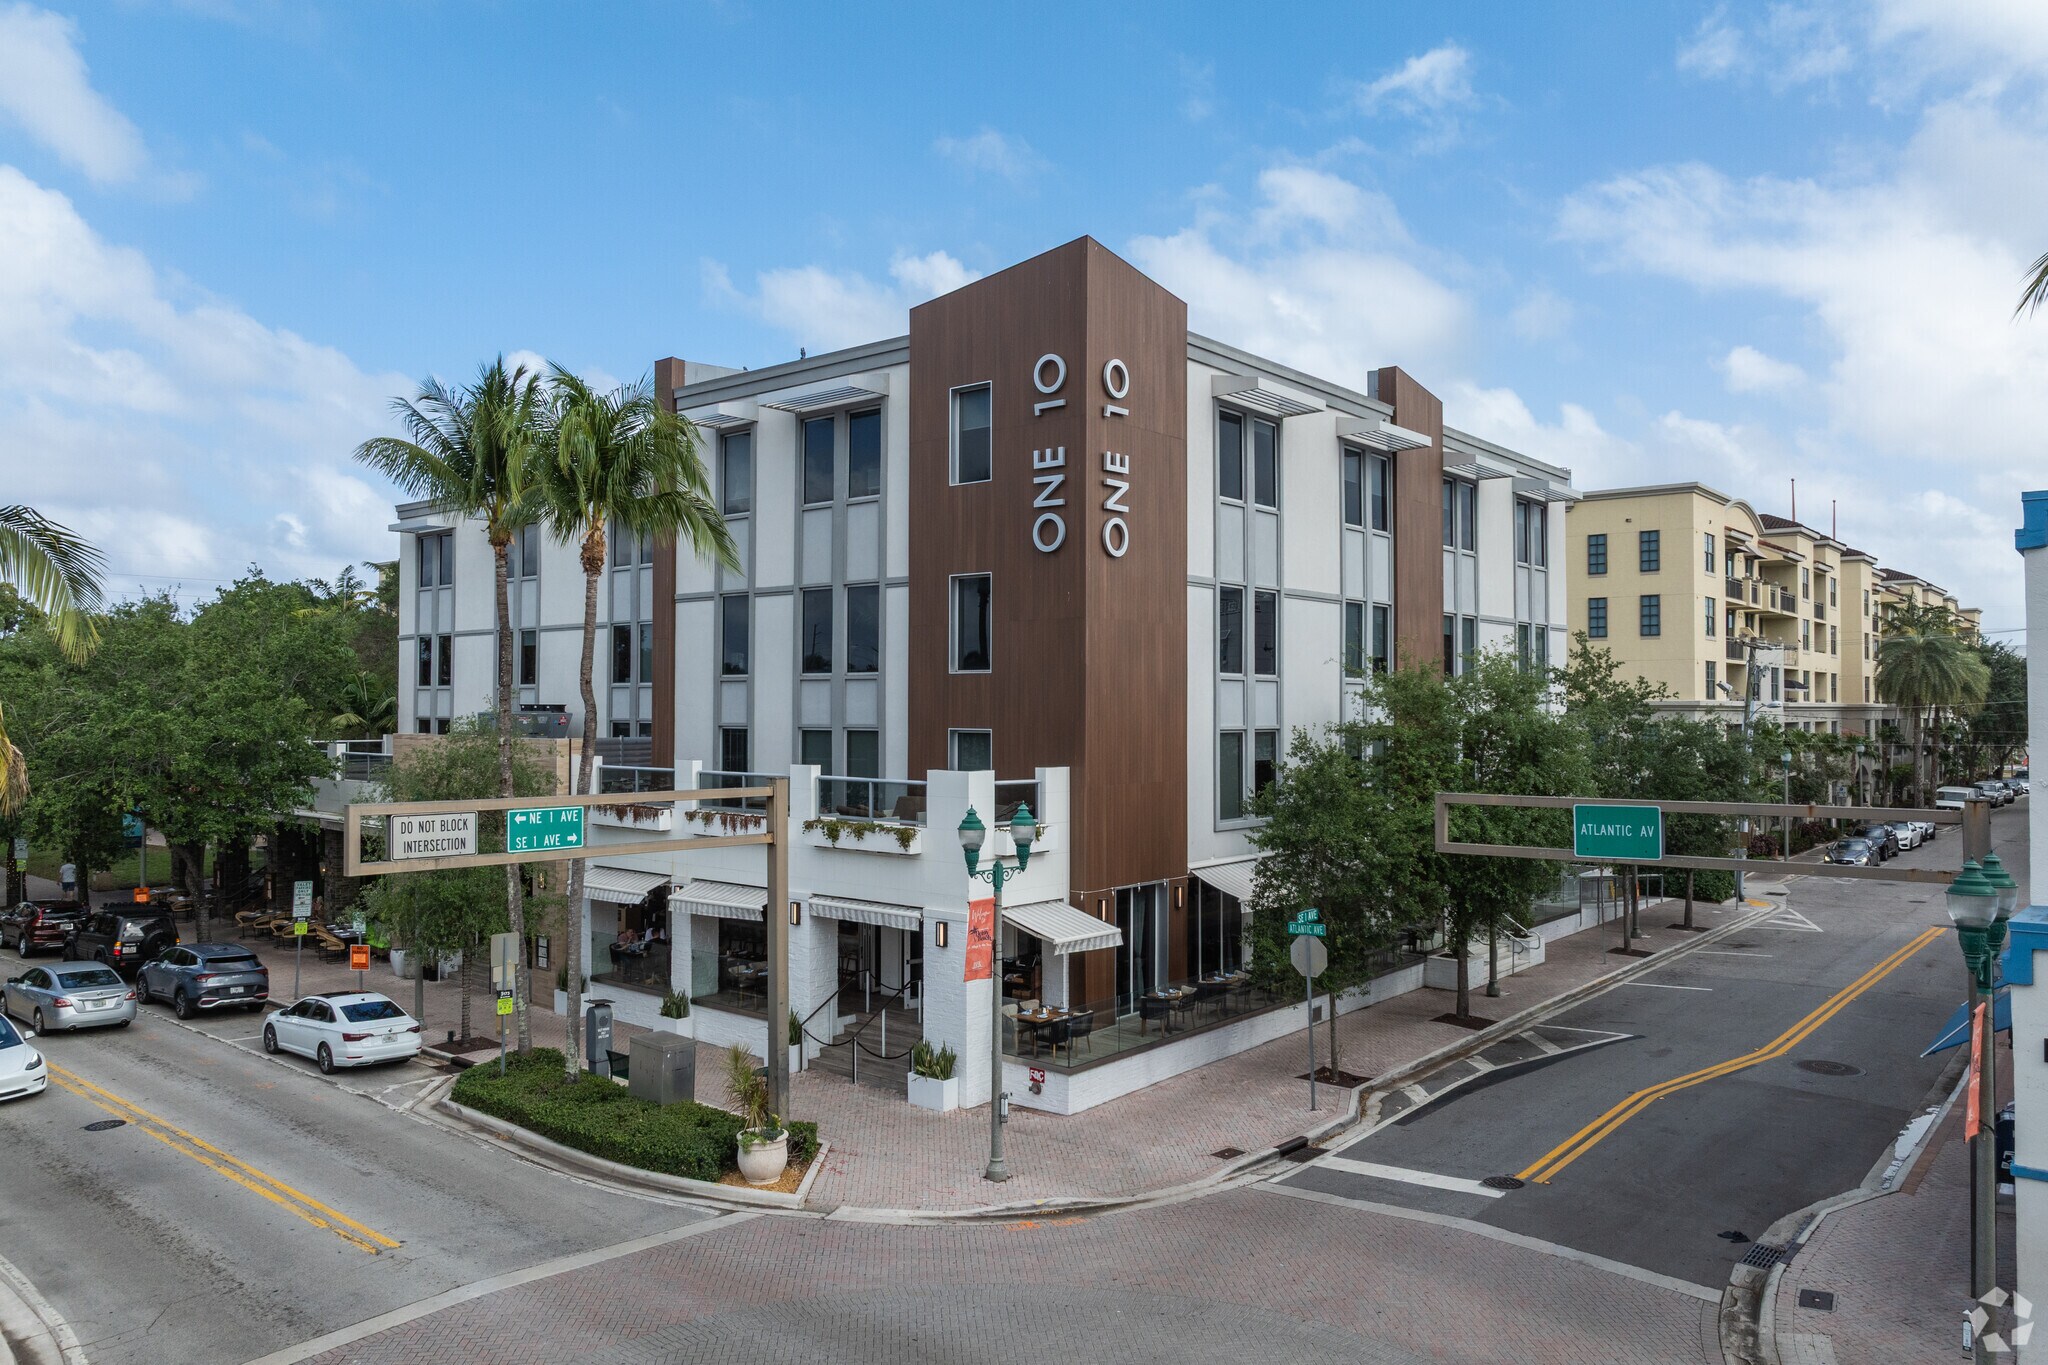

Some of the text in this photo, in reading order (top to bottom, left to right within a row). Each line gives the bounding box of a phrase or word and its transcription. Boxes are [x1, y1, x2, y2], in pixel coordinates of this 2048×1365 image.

[1033, 353, 1067, 552] ONE 10
[1102, 358, 1130, 558] ONE 10
[529, 812, 543, 825] NE
[560, 810, 579, 823] AVE
[400, 818, 469, 835] DO NOT BLOCK
[1580, 823, 1655, 838] ATLANTIC AV
[403, 837, 467, 854] INTERSECTION
[515, 836, 528, 849] SE
[543, 833, 561, 847] AVE
[1308, 910, 1317, 919] AVE
[1290, 924, 1323, 935] ATLANTIC AVE
